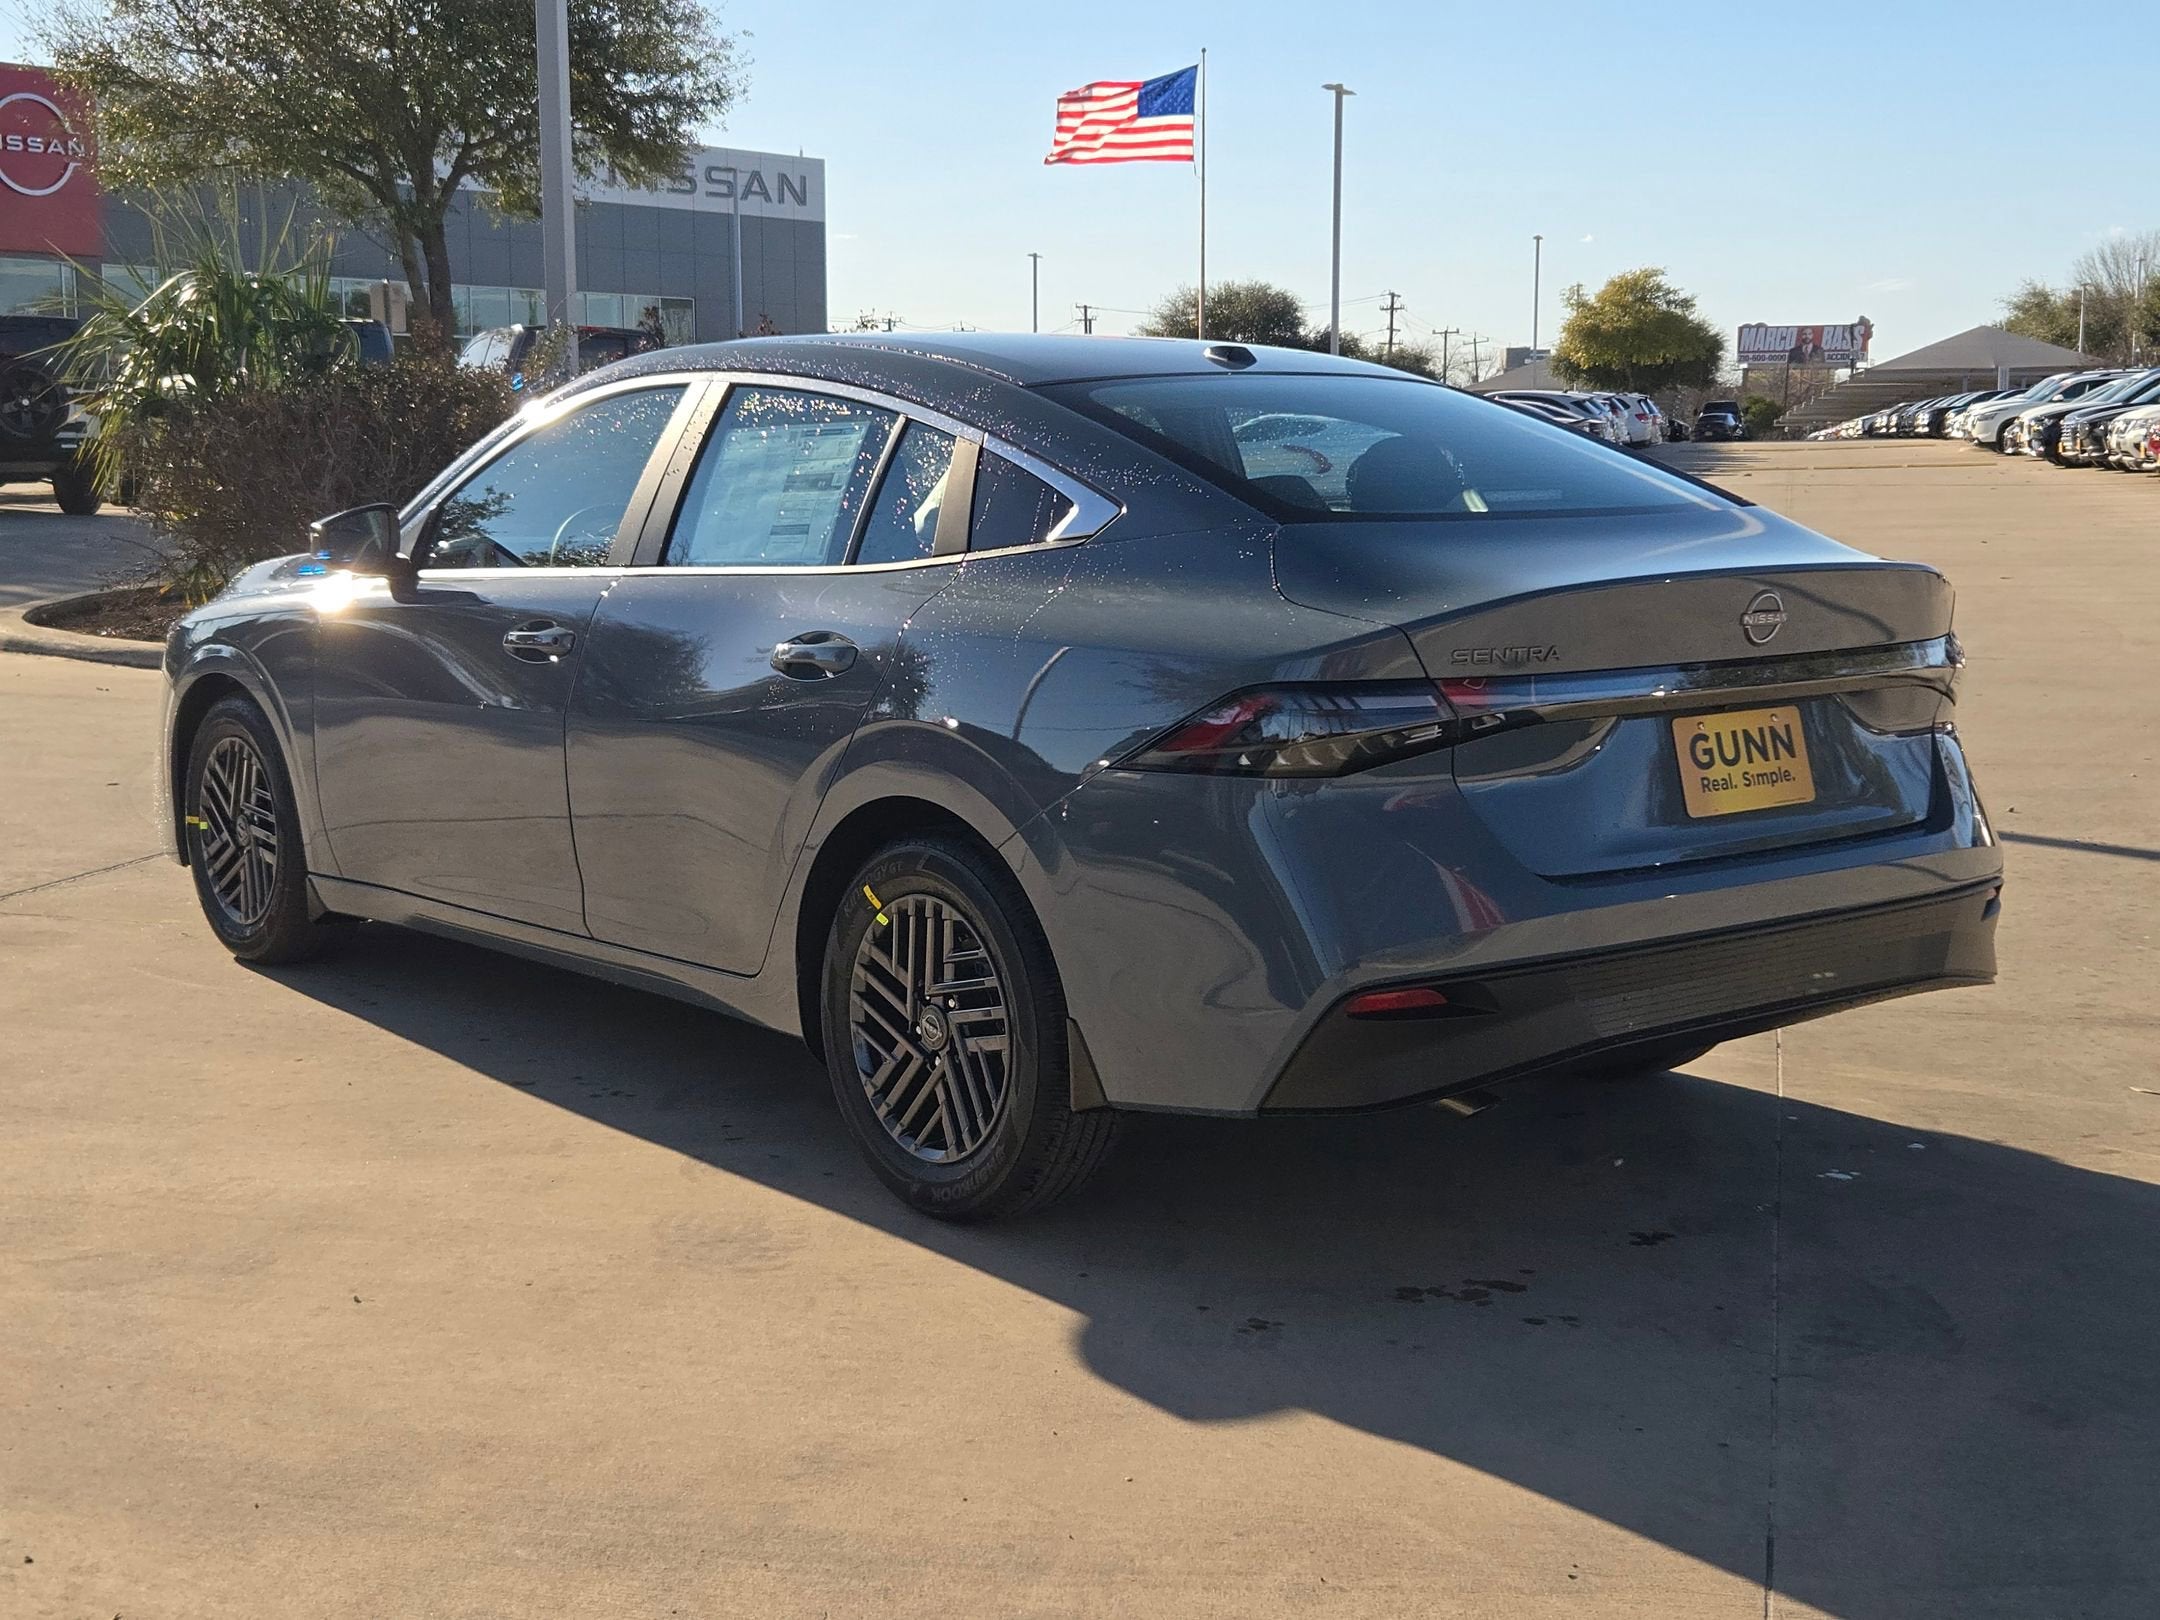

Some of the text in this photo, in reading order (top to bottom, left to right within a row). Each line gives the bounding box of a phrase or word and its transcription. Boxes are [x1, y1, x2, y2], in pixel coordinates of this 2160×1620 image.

[1740, 325, 1865, 351] MARCO BASS
[1743, 612, 1787, 624] NISSAN
[1451, 645, 1560, 665] SENTRA
[1689, 724, 1797, 771] GUNN
[1700, 766, 1797, 794] Real. Simple.
